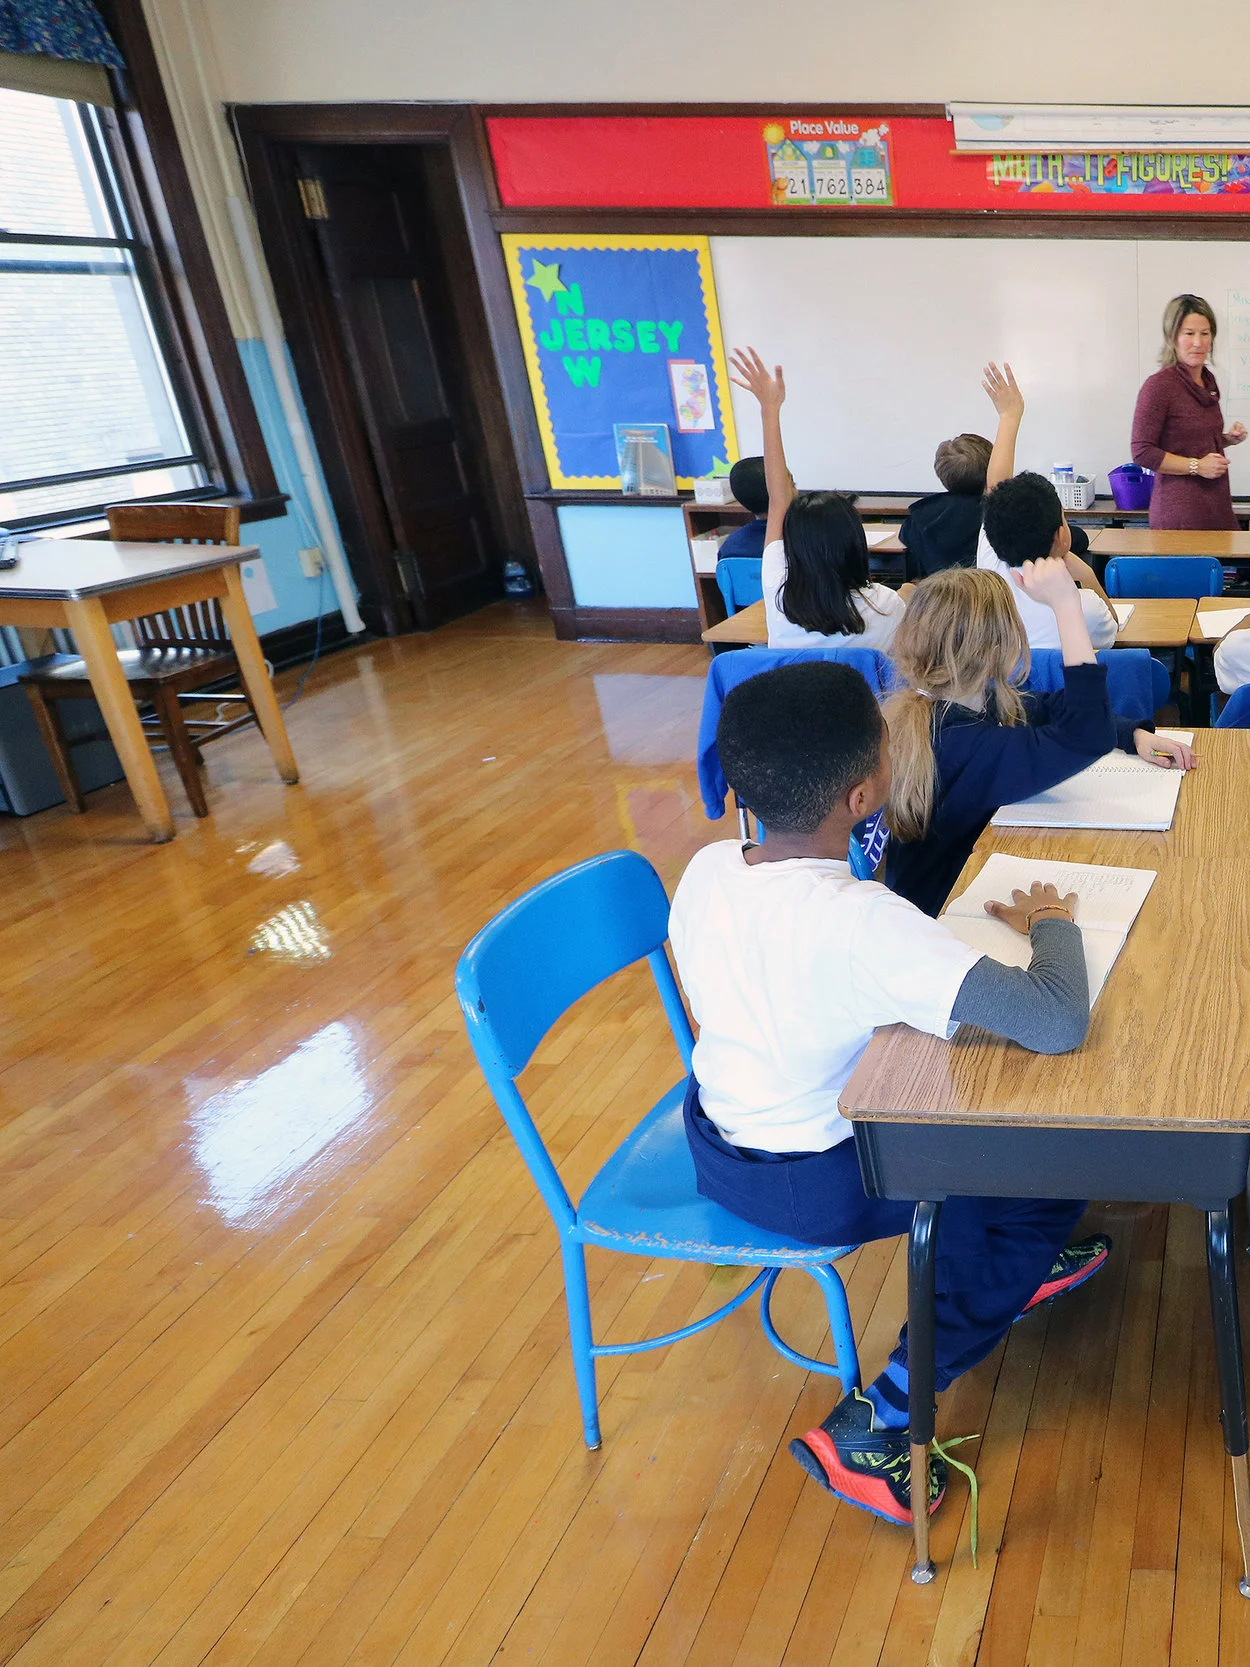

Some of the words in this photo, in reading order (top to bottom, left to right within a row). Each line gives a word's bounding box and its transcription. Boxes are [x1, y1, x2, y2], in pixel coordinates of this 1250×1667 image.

[789, 119, 823, 135] Place
[824, 119, 859, 135] Value
[540, 318, 683, 354] JERSEY
